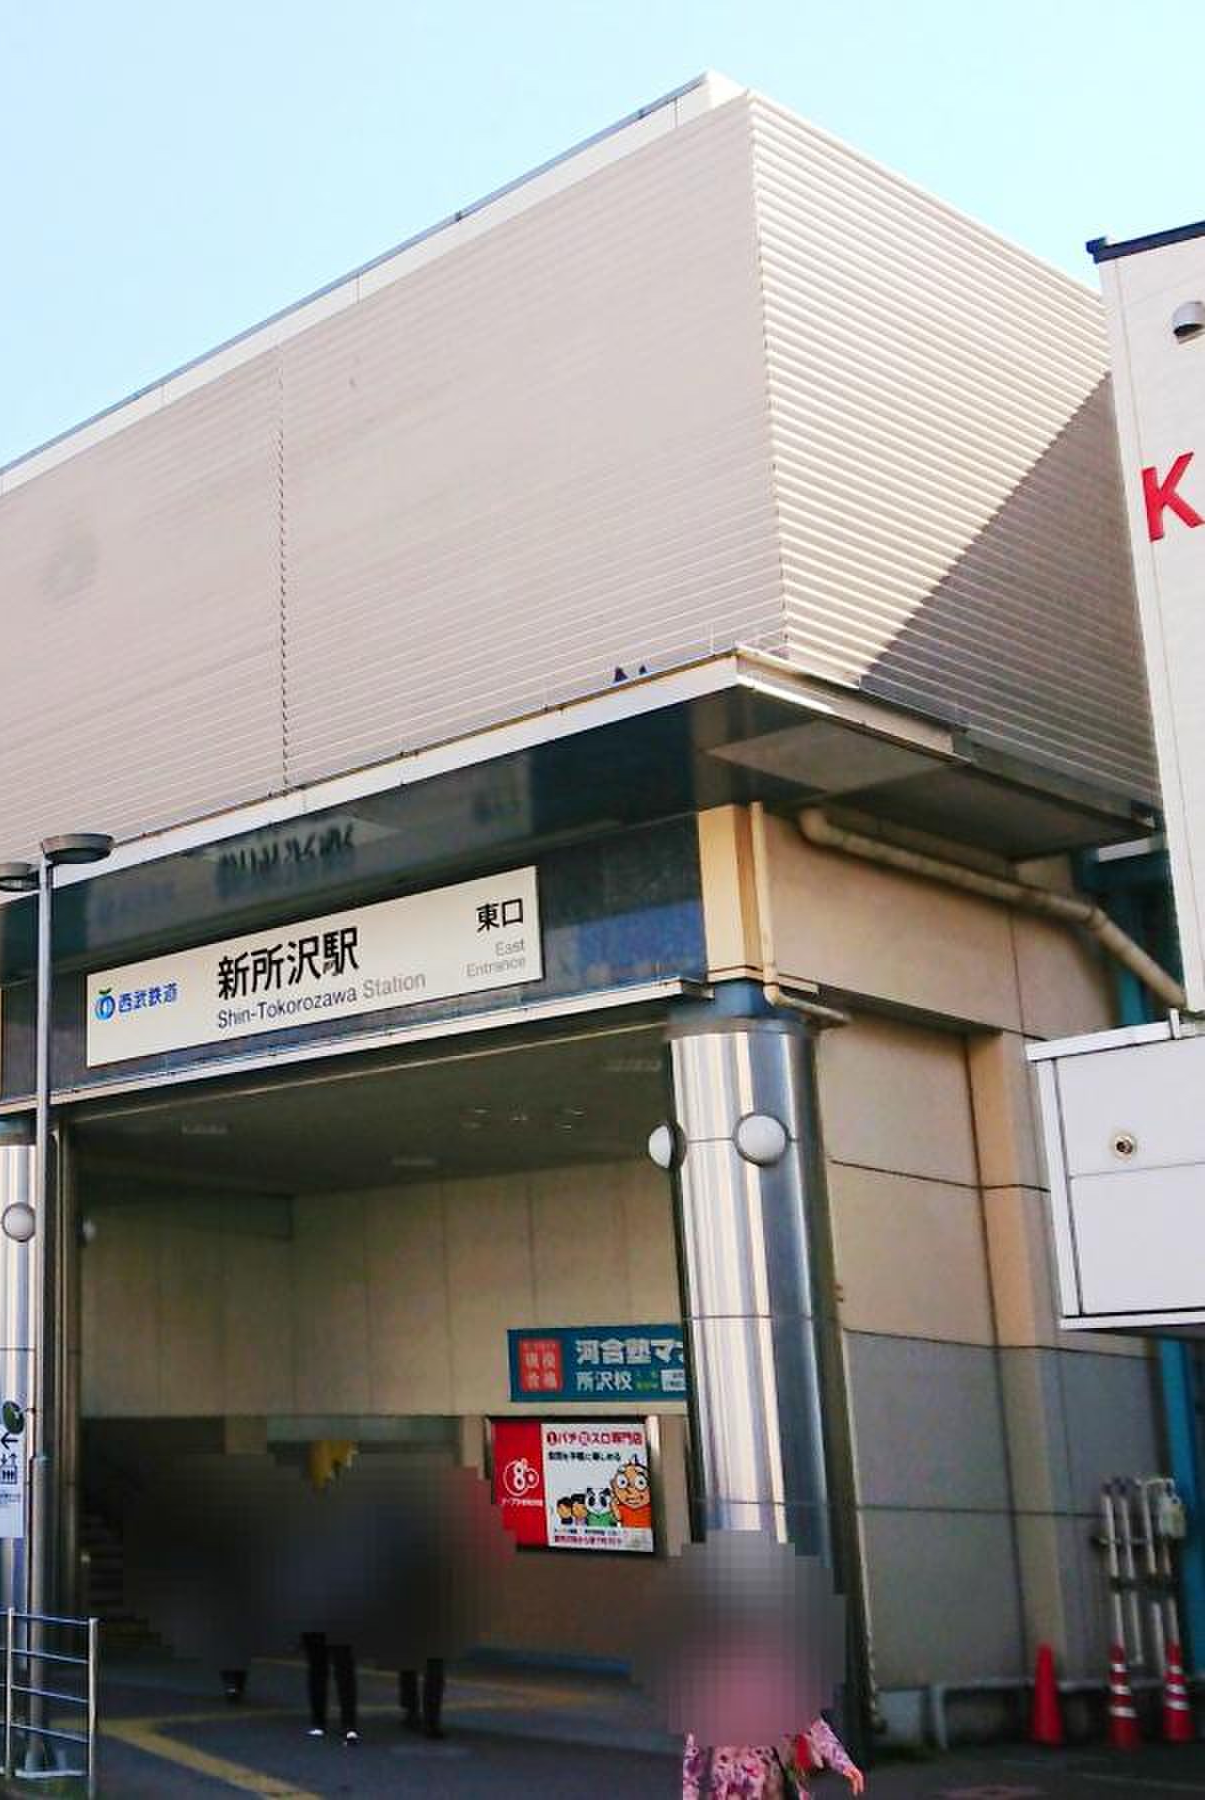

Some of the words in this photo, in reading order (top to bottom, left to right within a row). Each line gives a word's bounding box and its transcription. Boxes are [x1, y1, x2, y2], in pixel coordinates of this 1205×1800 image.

[1141, 452, 1205, 542] K
[476, 898, 524, 933] 東口
[218, 926, 359, 1000] 新所沢駅
[495, 939, 525, 957] East
[466, 957, 526, 977] Entrance
[118, 982, 178, 1013] 西武鉄道
[218, 987, 357, 1029] Shin-Tokorozawa
[363, 973, 426, 999] Station
[575, 1371, 633, 1392] 所沢校
